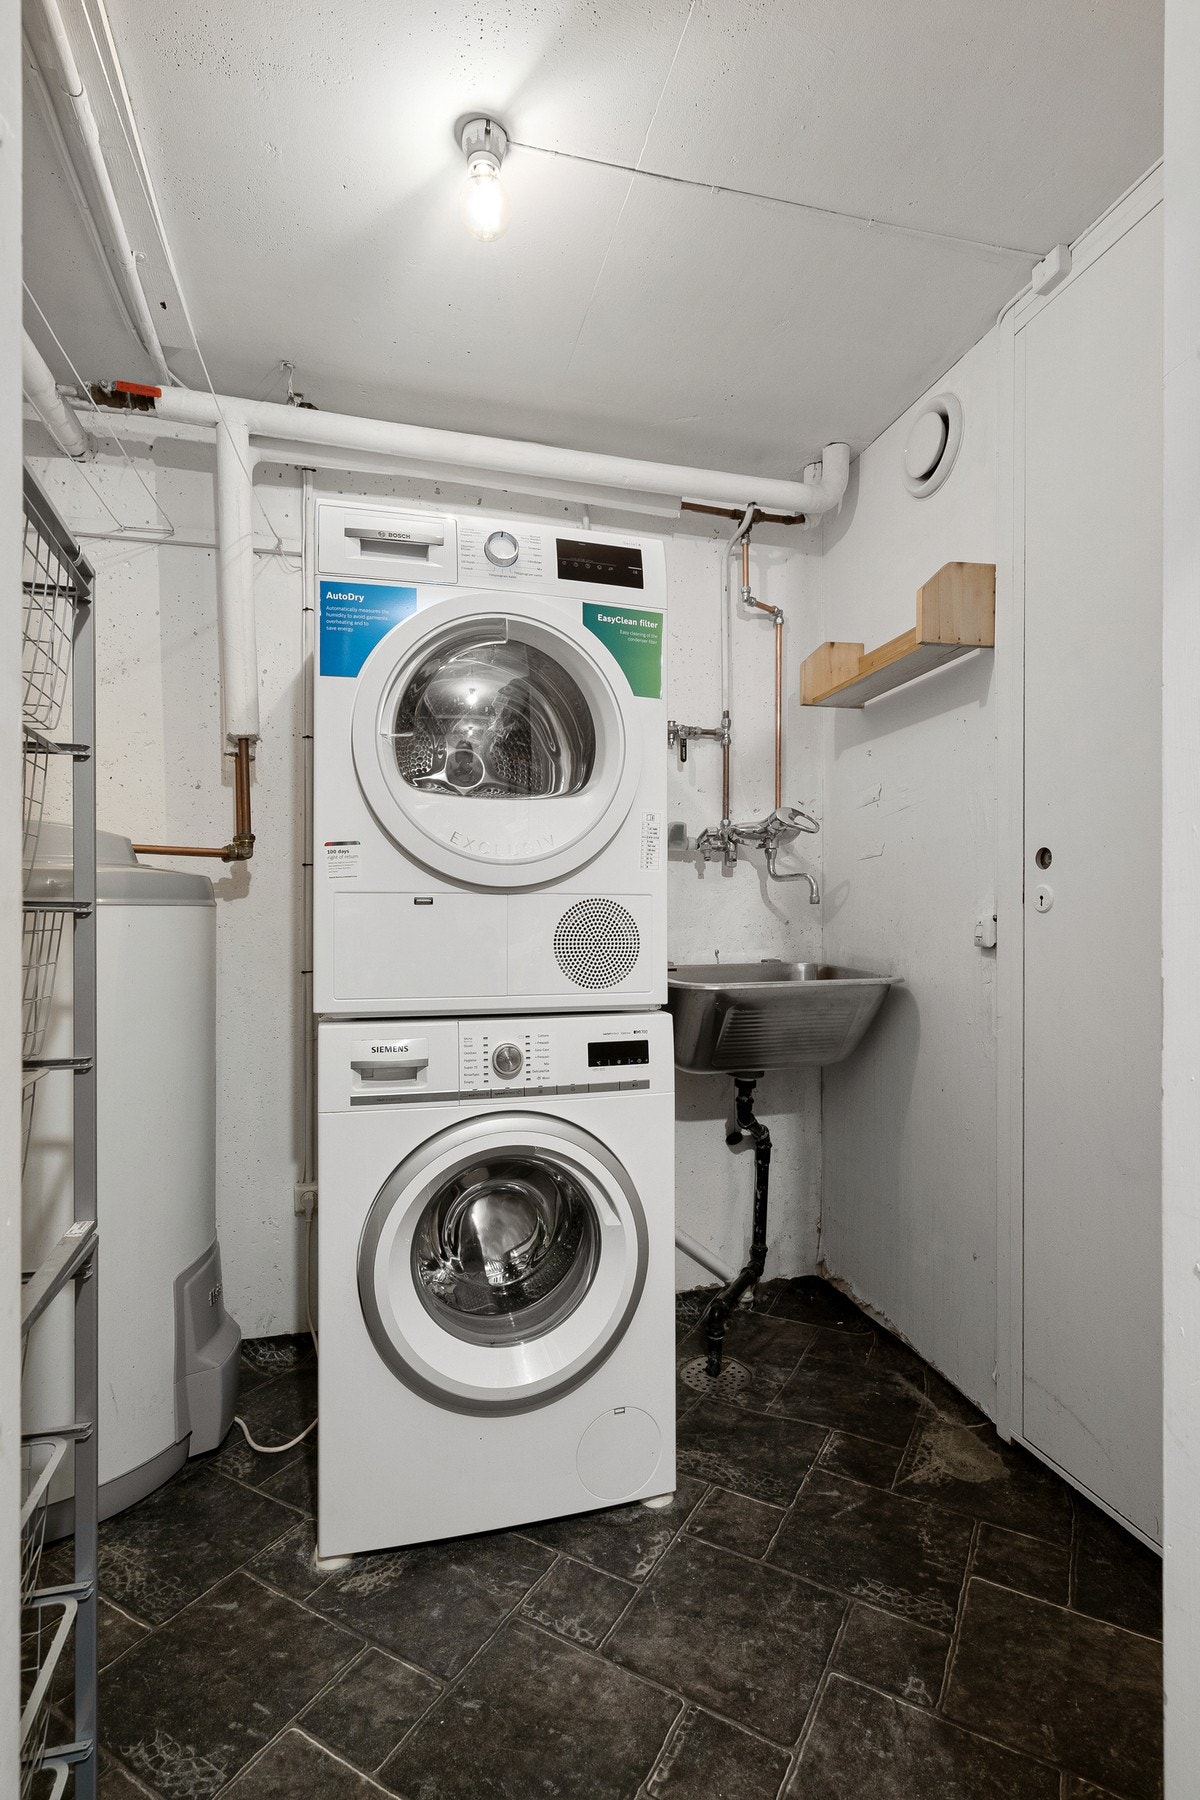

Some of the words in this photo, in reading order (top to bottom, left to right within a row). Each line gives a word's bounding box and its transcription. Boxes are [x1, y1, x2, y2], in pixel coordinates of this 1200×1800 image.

[326, 591, 365, 603] AutoDry
[597, 613, 638, 625] EasyClean
[639, 618, 659, 629] filter
[629, 630, 646, 638] cleaning
[371, 1045, 409, 1054] SIEMENS
